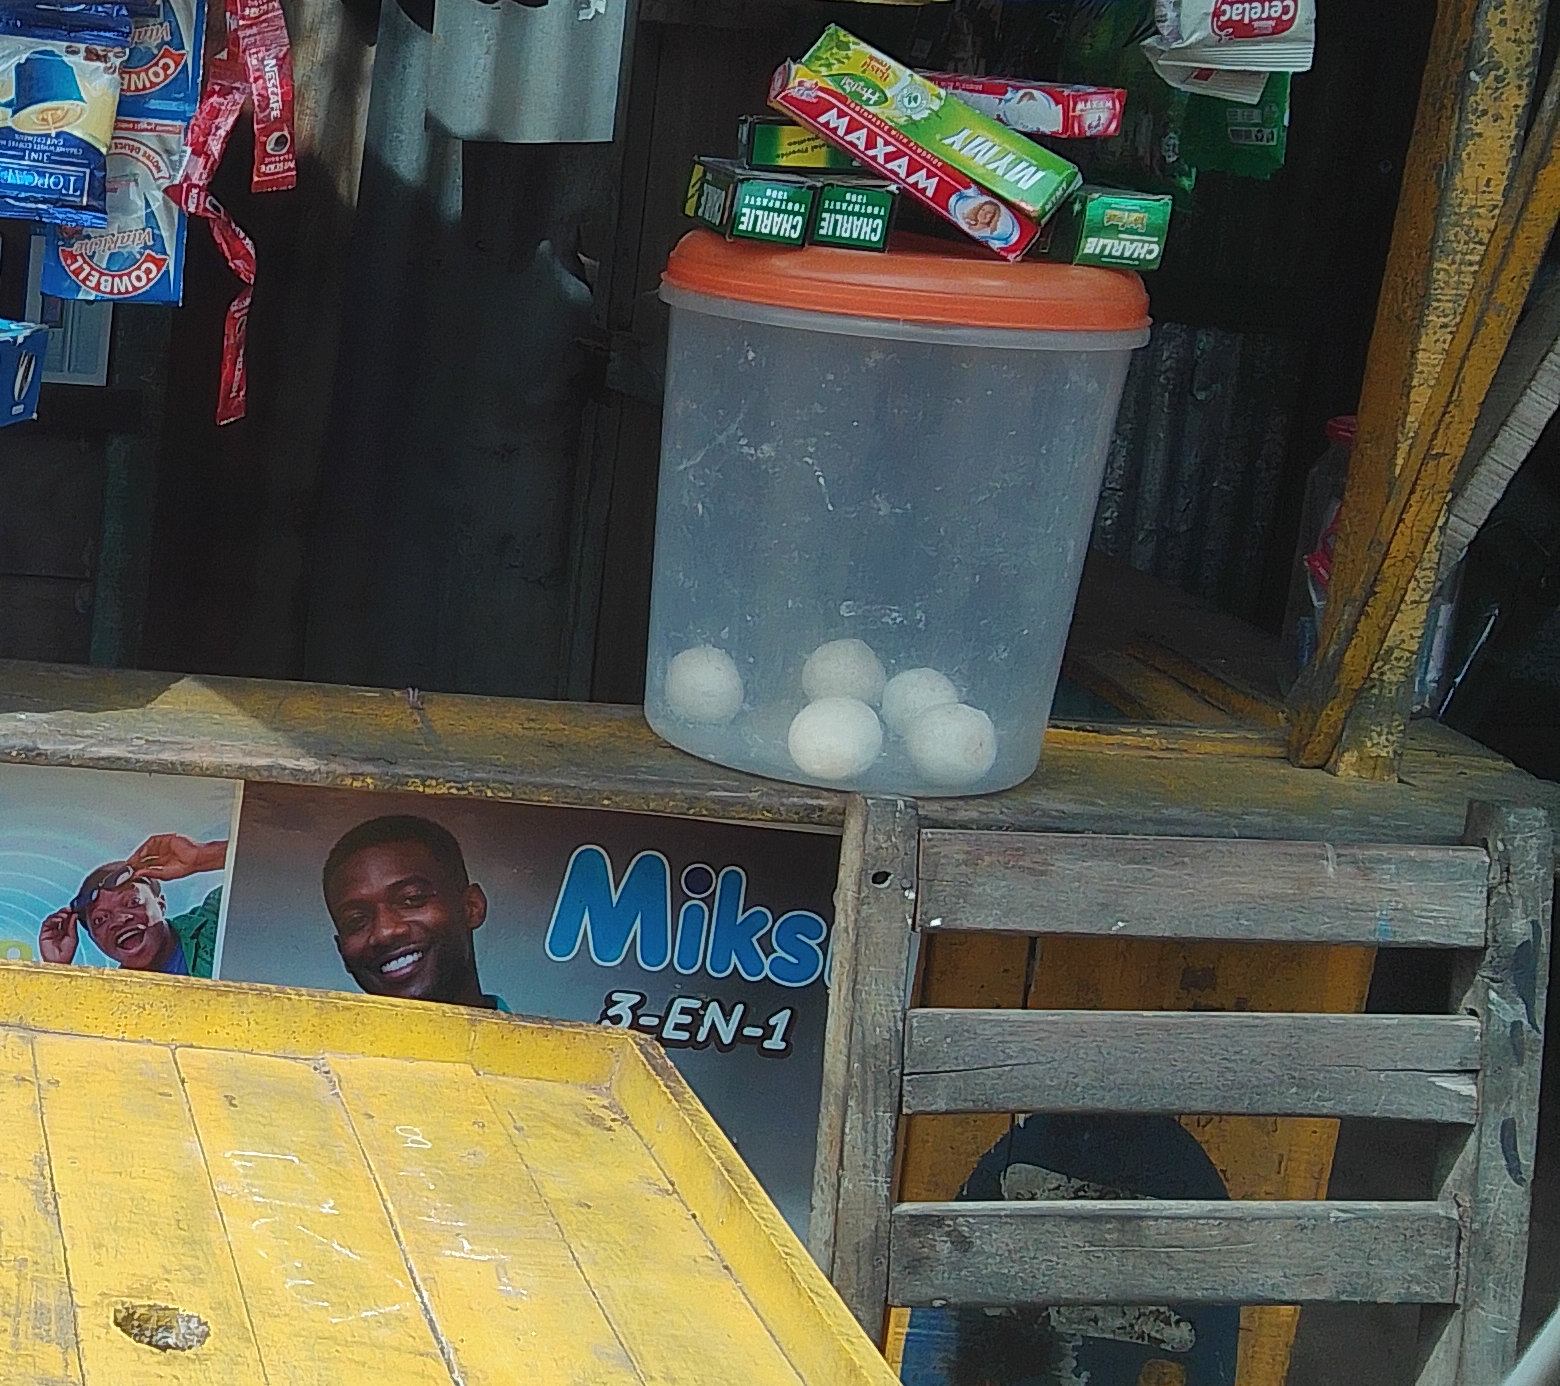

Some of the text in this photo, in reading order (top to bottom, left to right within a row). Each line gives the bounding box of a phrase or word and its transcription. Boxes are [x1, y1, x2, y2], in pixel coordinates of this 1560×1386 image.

[1219, 0, 1295, 24] Cerelac
[120, 57, 175, 91] COWB
[263, 57, 283, 121] NESCAFE
[818, 107, 940, 200] MAXAM
[941, 127, 1045, 191] MYMY
[744, 194, 806, 213] TOOTHPASTE
[738, 207, 803, 239] CHARLIE
[818, 212, 883, 241] CHARLIE
[1083, 237, 1159, 260] CHARLIE
[70, 255, 157, 293] COWBELL
[543, 842, 833, 988] Miks
